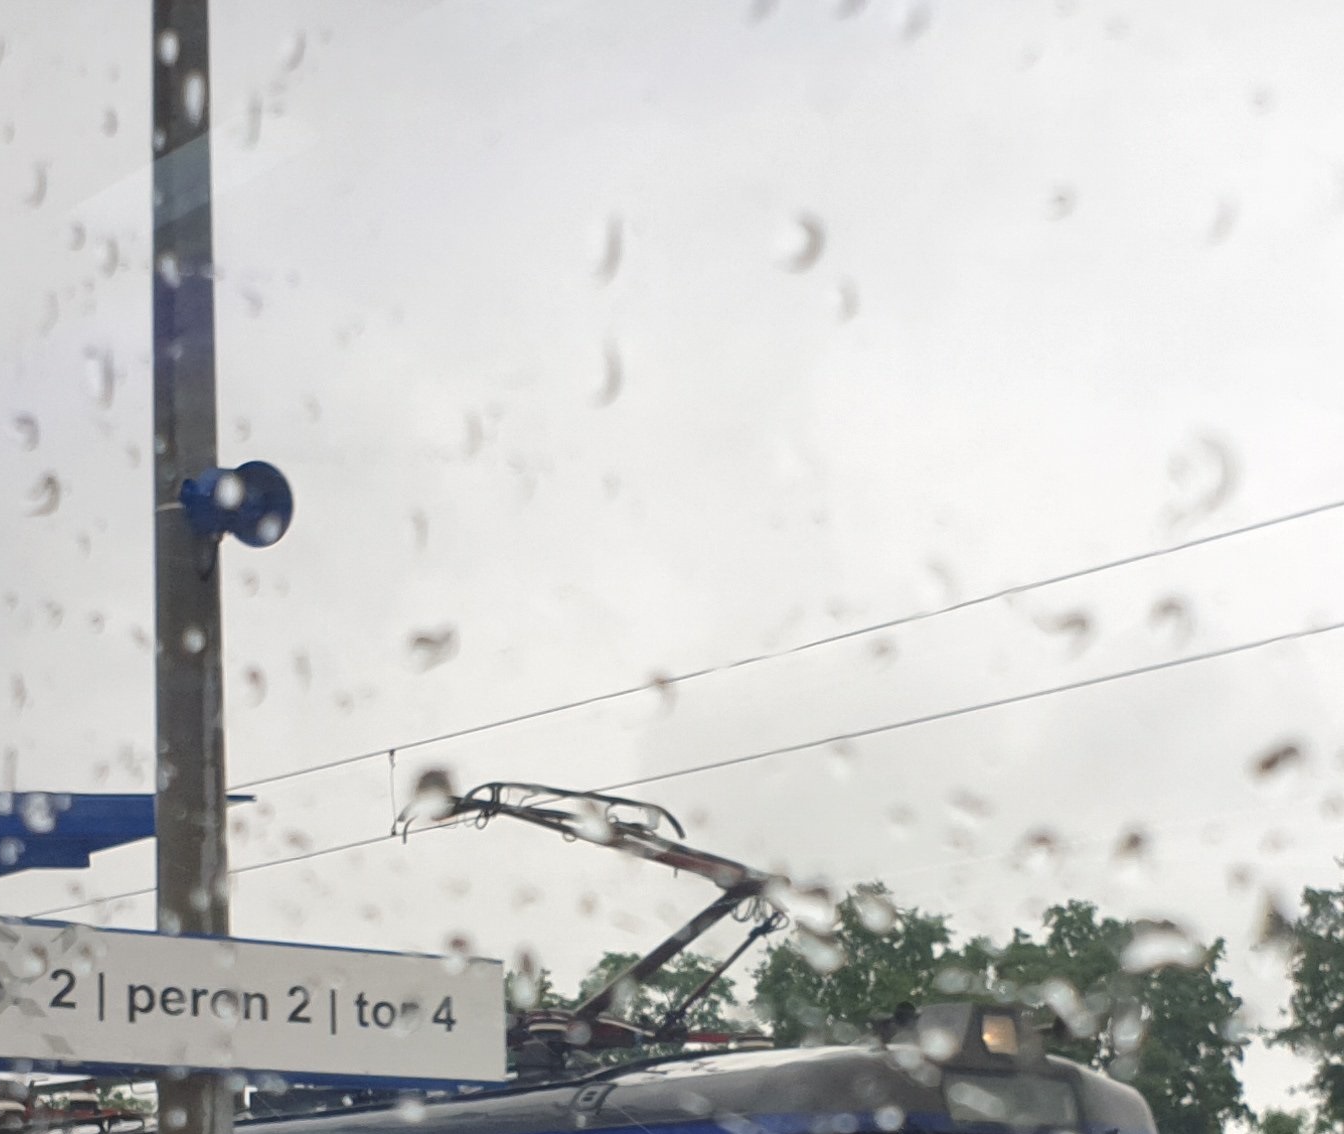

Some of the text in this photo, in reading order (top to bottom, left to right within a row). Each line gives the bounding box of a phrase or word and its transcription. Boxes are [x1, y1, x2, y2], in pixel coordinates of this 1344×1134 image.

[49, 968, 78, 1009] 2
[126, 982, 269, 1024] peron
[287, 985, 312, 1024] 2
[431, 996, 457, 1033] 4
